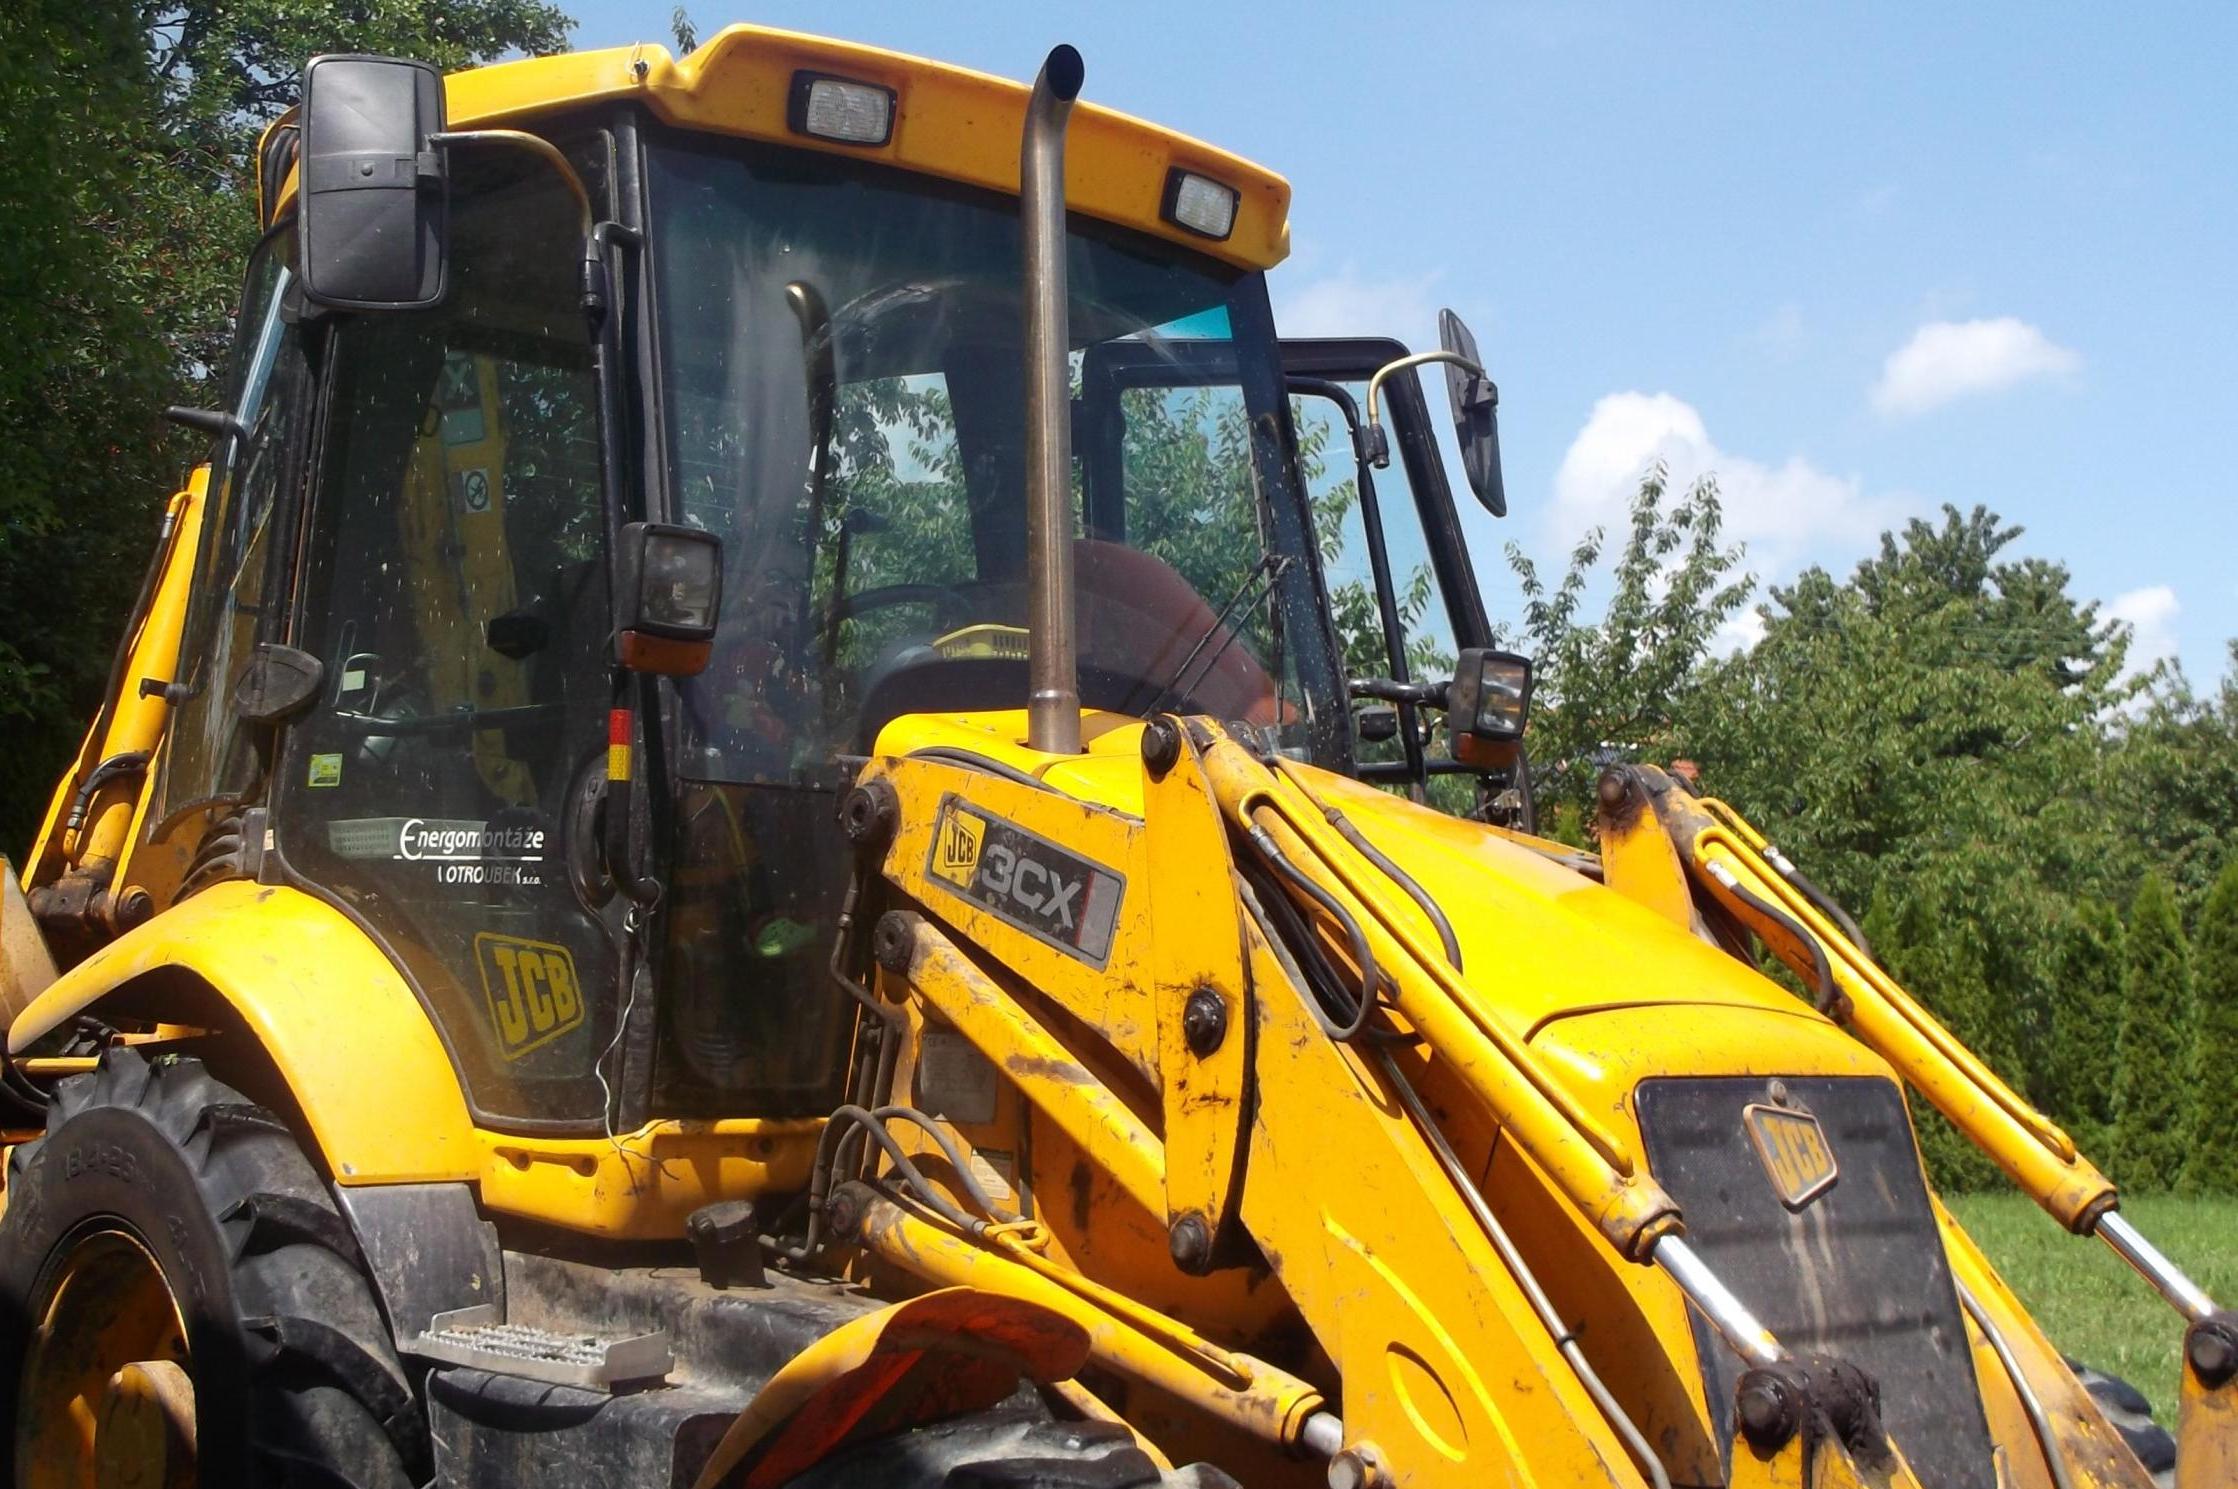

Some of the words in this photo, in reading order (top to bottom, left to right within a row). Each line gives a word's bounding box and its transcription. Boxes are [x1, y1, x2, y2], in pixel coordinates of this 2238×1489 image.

[399, 818, 545, 861] Energomontáže
[947, 822, 974, 863] JCB
[981, 843, 1082, 929] 3CX
[493, 946, 577, 1045] JCB
[1761, 1116, 1829, 1196] JCB
